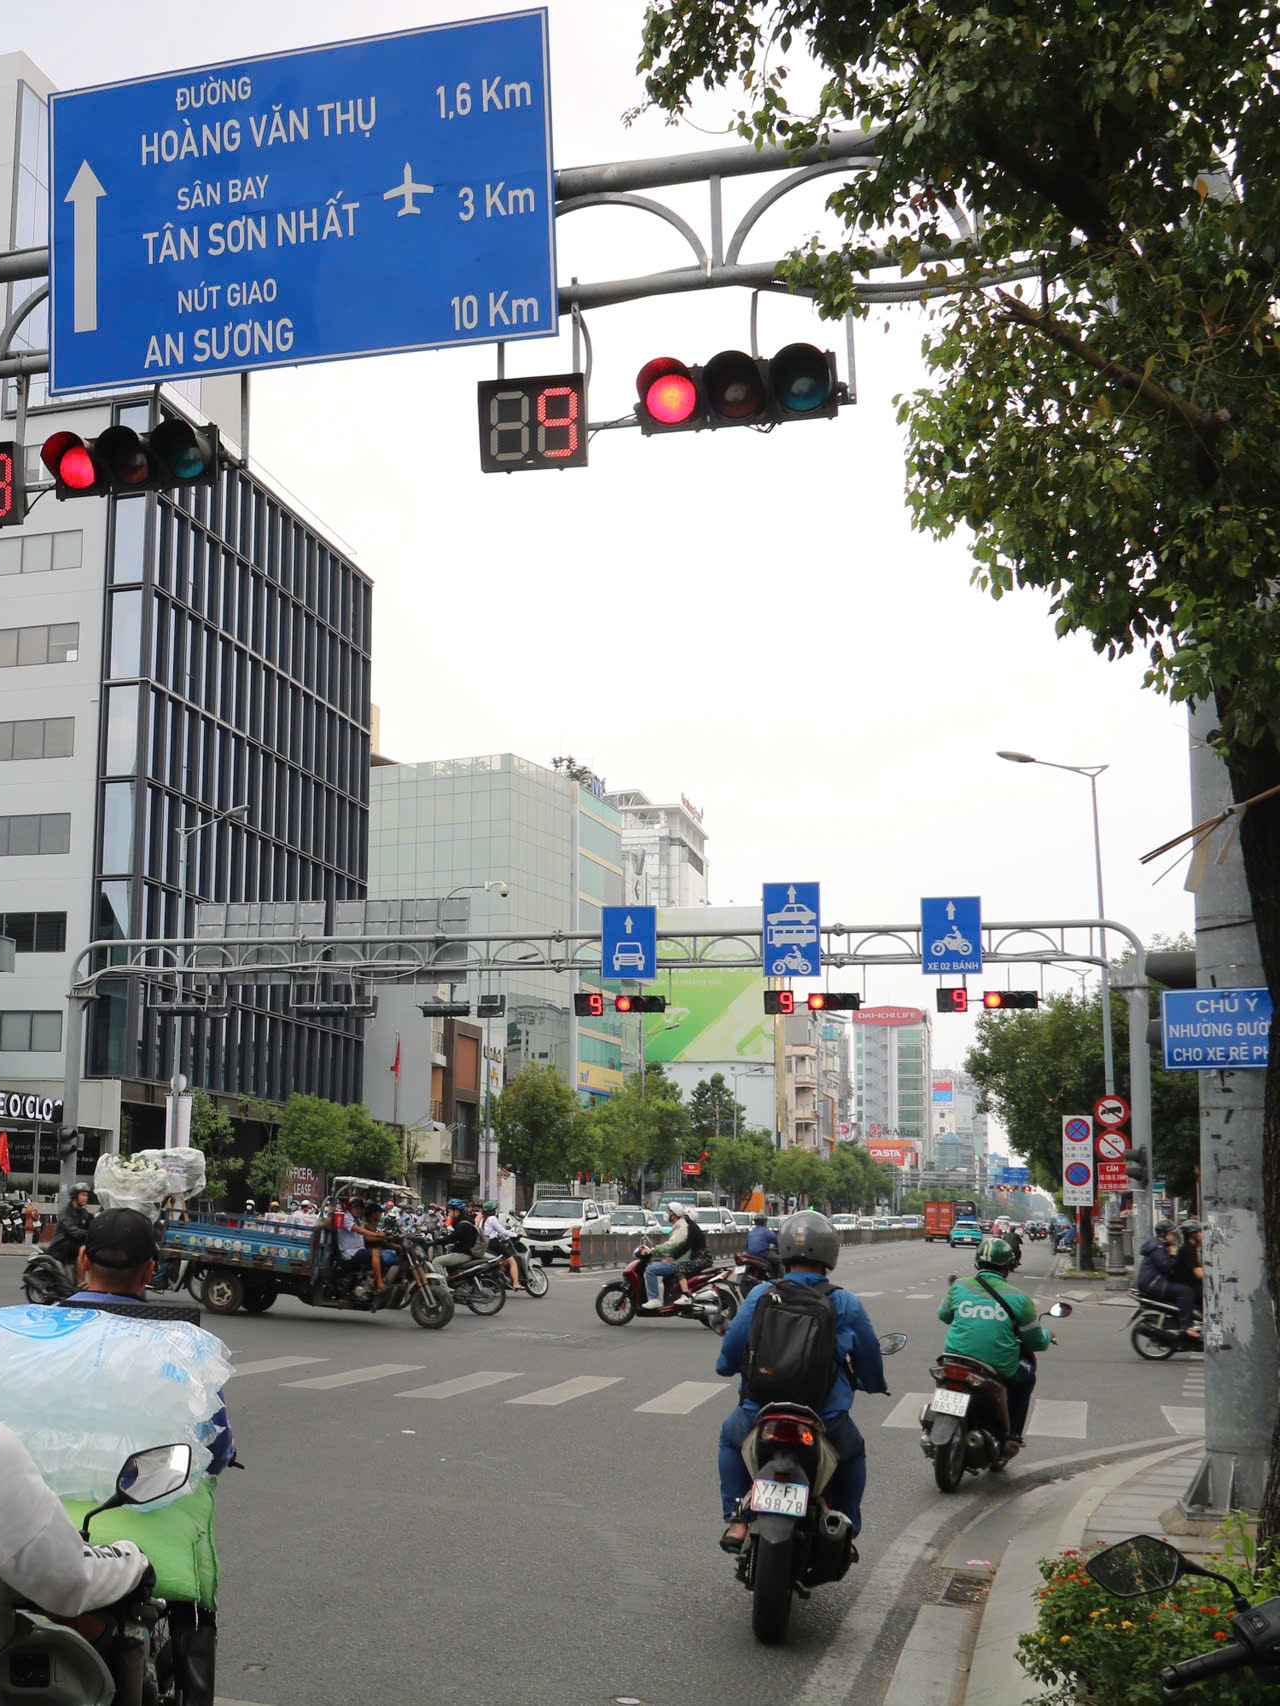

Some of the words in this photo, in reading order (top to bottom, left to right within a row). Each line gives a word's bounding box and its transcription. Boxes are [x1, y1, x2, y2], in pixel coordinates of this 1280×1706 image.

[176, 76, 252, 111] ĐƯỜNG
[141, 117, 241, 166] HOÀNG
[250, 104, 309, 148] VĂN
[317, 96, 377, 138] THỤ
[436, 82, 472, 120] 1,6
[482, 76, 532, 111] Km
[177, 178, 224, 210] SÂN
[228, 174, 269, 205] BAY
[142, 222, 199, 265] TÂN
[208, 214, 267, 253] SƠN
[277, 191, 360, 244] NHẤT
[458, 188, 474, 222] 3
[485, 182, 535, 217] Km
[177, 280, 221, 314] NÚT
[226, 278, 277, 308] GIAO
[144, 335, 184, 369] AN
[193, 318, 294, 361] SƯƠNG
[450, 296, 478, 331] 10
[489, 291, 540, 327] Km
[537, 387, 578, 458] 9
[928, 962, 939, 970] XE
[952, 960, 979, 970] BÁNH
[589, 994, 602, 1015] 9
[779, 991, 793, 1013] 9
[952, 989, 967, 1011] 9
[1195, 993, 1239, 1014] CHÚ
[1244, 992, 1258, 1012] Ý
[1169, 1018, 1233, 1038] NHƯỜNG
[1237, 1016, 1272, 1037] ĐƯỜ
[1173, 1047, 1203, 1062] CHO
[1206, 1047, 1226, 1061] XE
[1229, 1042, 1249, 1060] RẼ
[870, 1149, 901, 1157] CASTA
[293, 1183, 312, 1197] LEASE
[958, 1300, 1009, 1322] Grab
[761, 1482, 798, 1499] 77-F1
